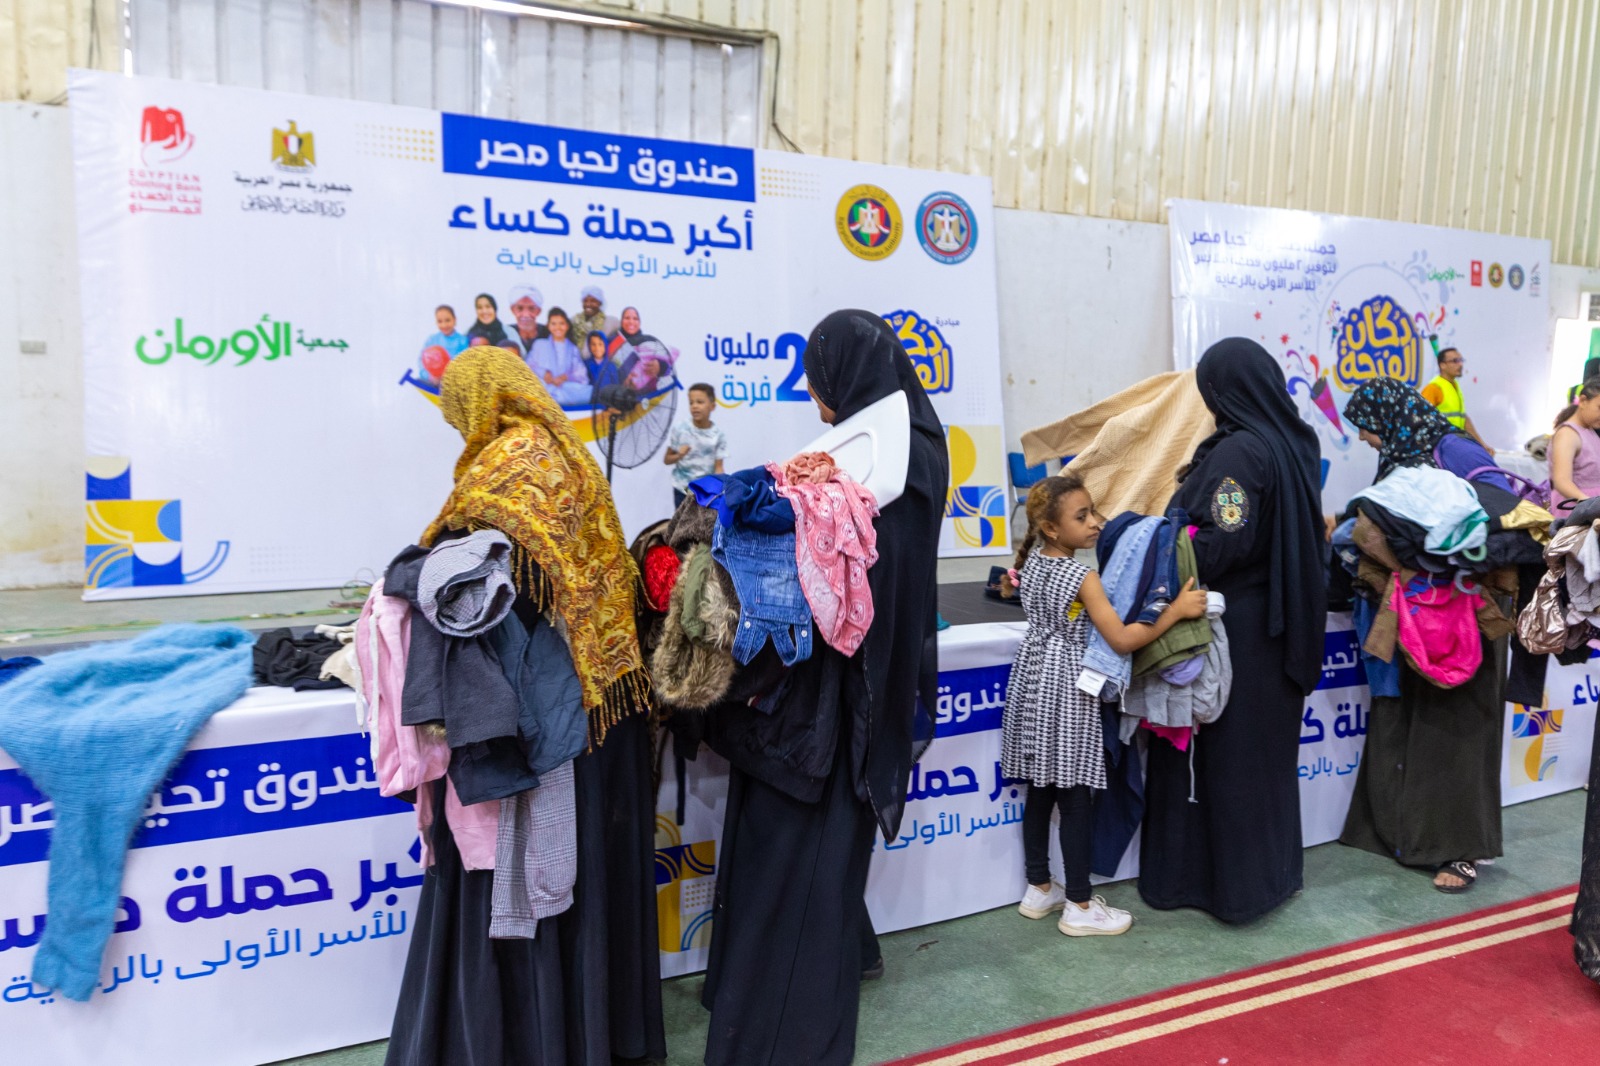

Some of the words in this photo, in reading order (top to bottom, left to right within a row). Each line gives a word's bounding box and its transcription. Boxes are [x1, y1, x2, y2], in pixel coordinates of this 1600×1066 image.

[476, 139, 549, 170] مصر
[558, 140, 621, 179] تحيا
[629, 148, 739, 188] صندوق
[278, 179, 301, 190] مصر
[306, 177, 352, 194] جمهورية
[448, 197, 570, 236] كساء
[583, 203, 675, 244] حملة
[684, 208, 753, 257] أكبر
[1189, 230, 1221, 246] مصر
[496, 248, 582, 273] بالرعاية
[587, 254, 657, 277] الأولى
[662, 258, 717, 279] للأسر
[135, 313, 292, 366] الأورمان
[935, 316, 960, 327] مبادرة
[296, 330, 349, 352] جمعية
[704, 332, 769, 365] مليون
[774, 332, 812, 402] 2
[722, 374, 771, 407] فرحة
[1322, 643, 1359, 678] تحي
[936, 682, 1006, 725] ندوق
[143, 768, 230, 829] تحي
[243, 757, 380, 814] ندوق
[905, 763, 979, 803] حمل
[884, 812, 960, 850] الأولى
[966, 802, 1024, 837] للأسر
[165, 865, 333, 923] حملة
[310, 910, 406, 957] للأسر
[176, 928, 300, 980] الأولى
